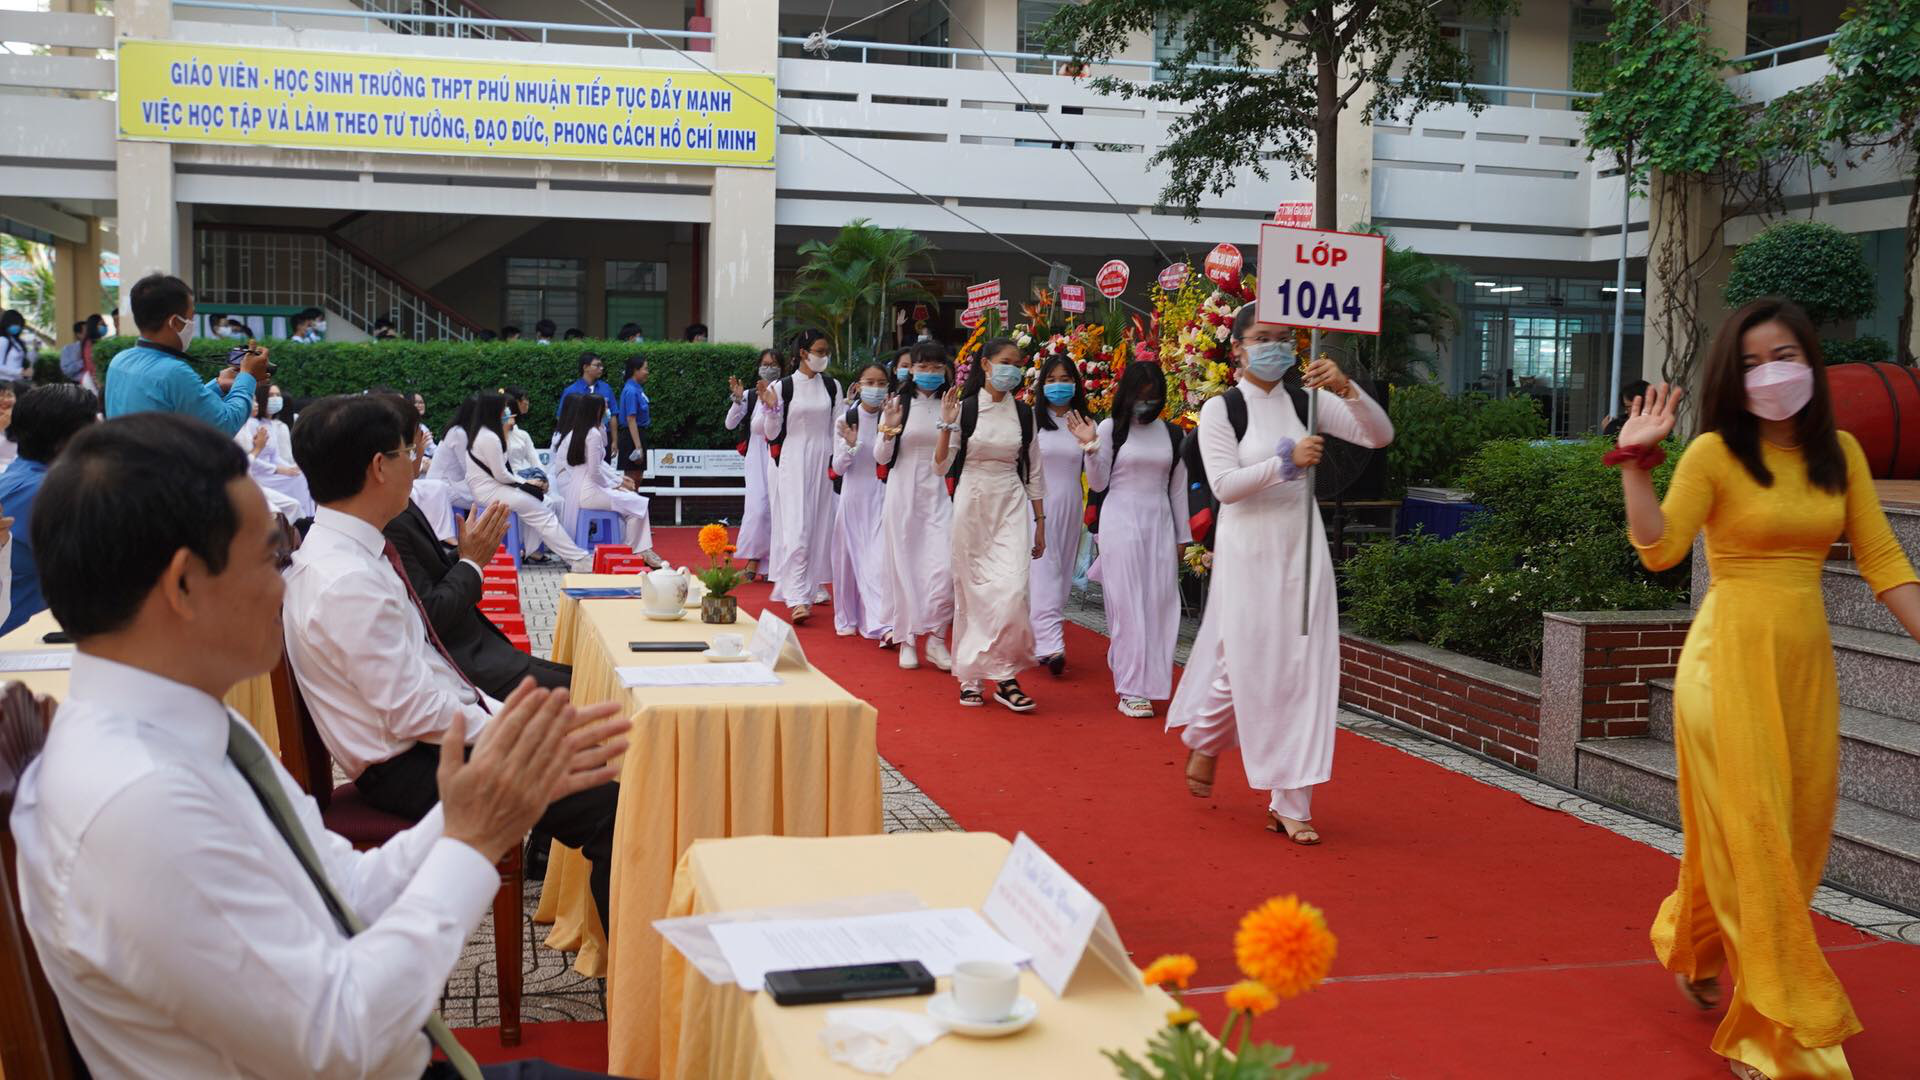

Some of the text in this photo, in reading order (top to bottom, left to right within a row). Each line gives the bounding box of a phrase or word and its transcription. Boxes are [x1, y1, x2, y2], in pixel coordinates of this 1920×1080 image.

[171, 57, 213, 87] GIÁO
[218, 61, 258, 89] VIÊN
[273, 69, 309, 97] HỌC
[314, 71, 353, 94] SINH
[359, 69, 425, 98] TRƯỜNG
[431, 77, 472, 100] THPT
[478, 75, 509, 102] PHÚ
[515, 79, 570, 111] NHUẬN
[576, 77, 611, 106] TIẾP
[616, 86, 646, 114] TỤC
[650, 78, 682, 110] ĐẨY
[687, 90, 731, 117] MẠNH
[141, 96, 183, 131] VIỆC
[188, 104, 224, 133] HỌC
[229, 102, 262, 134] TẬP
[267, 103, 289, 130] VÀ
[295, 104, 329, 132] LÀM
[334, 112, 378, 135] THEO
[384, 112, 405, 136] TƯ
[474, 119, 507, 146] ĐẠO
[512, 115, 548, 146] ĐỨC,
[553, 122, 608, 145] PHONG
[613, 119, 655, 147] CÁCH
[660, 119, 681, 148] HỒ
[686, 124, 712, 149] CHÍ
[717, 128, 756, 151] MINH
[1296, 241, 1348, 267] LỚP
[1278, 279, 1362, 323] 10A4
